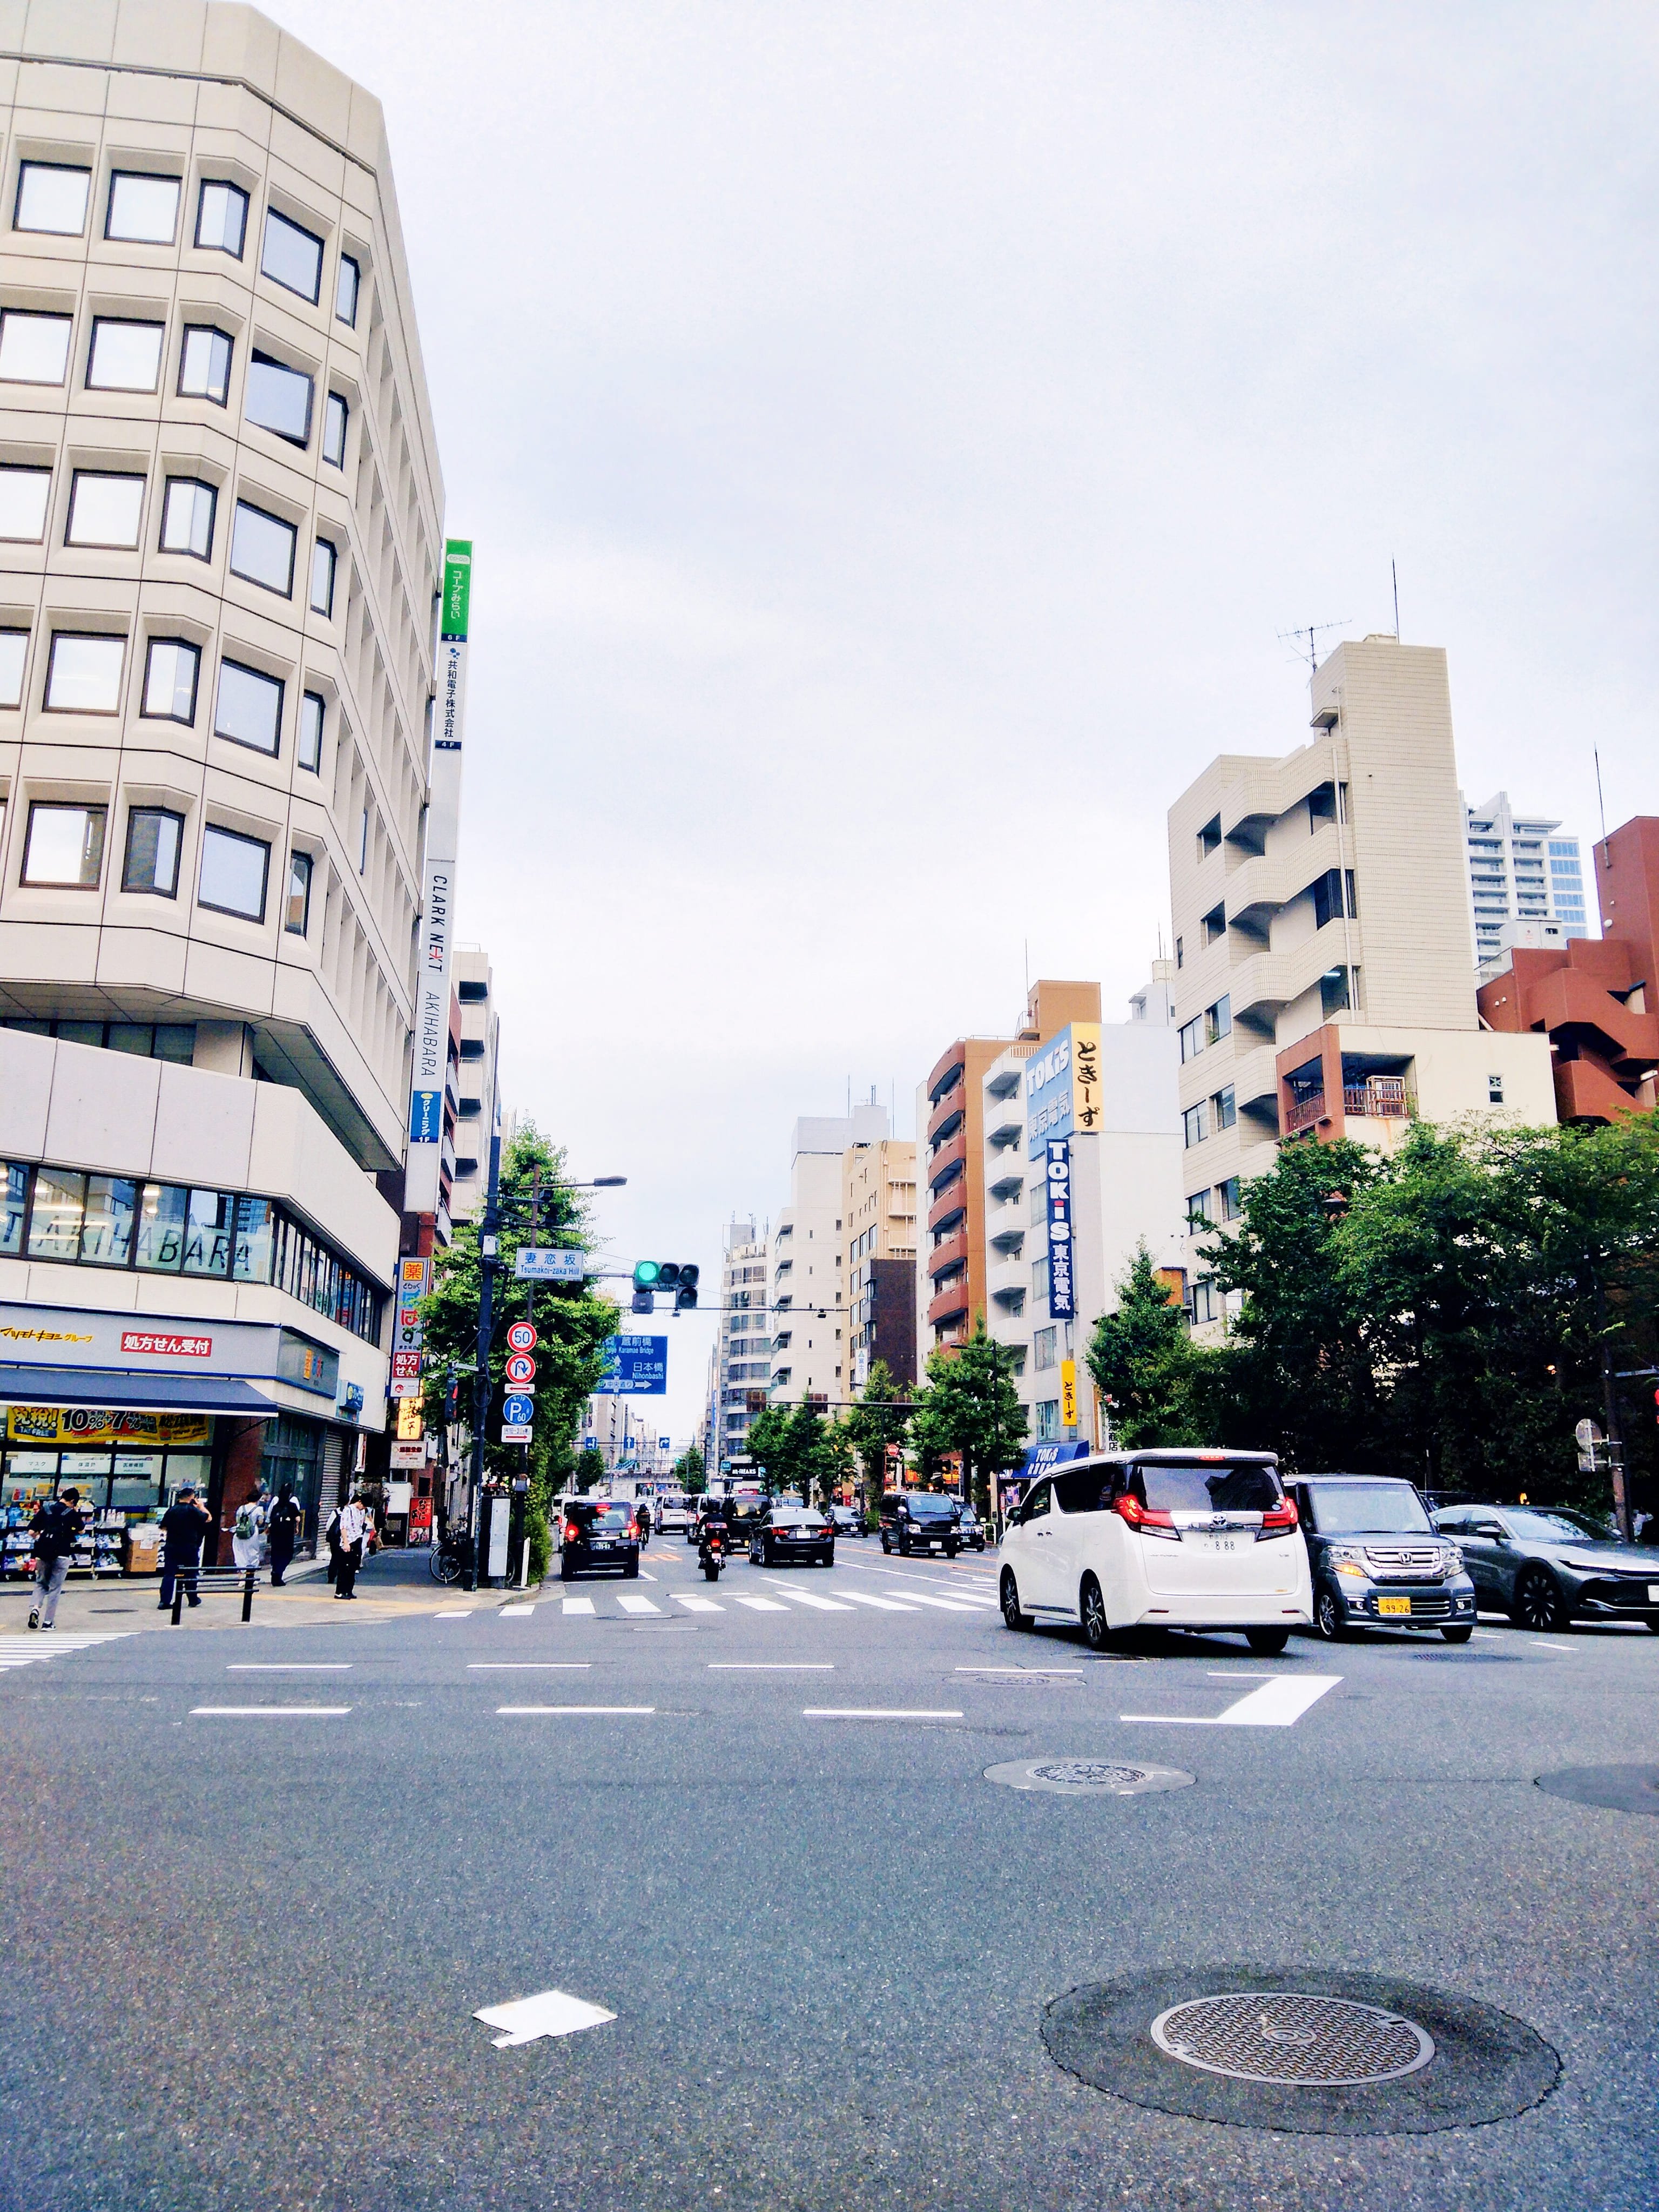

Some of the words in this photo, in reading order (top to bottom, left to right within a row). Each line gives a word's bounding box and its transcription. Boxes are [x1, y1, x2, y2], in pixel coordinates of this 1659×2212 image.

[451, 570, 463, 619] コープみらい
[444, 660, 458, 738] 共和電子株式会社
[431, 875, 448, 927] CLARK
[428, 933, 444, 973] NEXT
[421, 991, 440, 1076] AKIHABARA
[1077, 1041, 1100, 1127] ときーず
[1028, 1089, 1070, 1143] 東京電気
[525, 1252, 576, 1265] 妻恋坂
[406, 1264, 422, 1279] 薬
[521, 1265, 567, 1275] Tsumakoi-zaka
[569, 1267, 579, 1275] Hill
[1053, 1243, 1071, 1311] 東京電気
[124, 1334, 210, 1354] 処方せん受付
[515, 1331, 530, 1344] 50
[639, 1346, 654, 1355] Bridge
[396, 1354, 419, 1366] 処方
[633, 1362, 663, 1372] 日本橋
[517, 1412, 527, 1422] 60
[1386, 1604, 1410, 1613] 99-26
